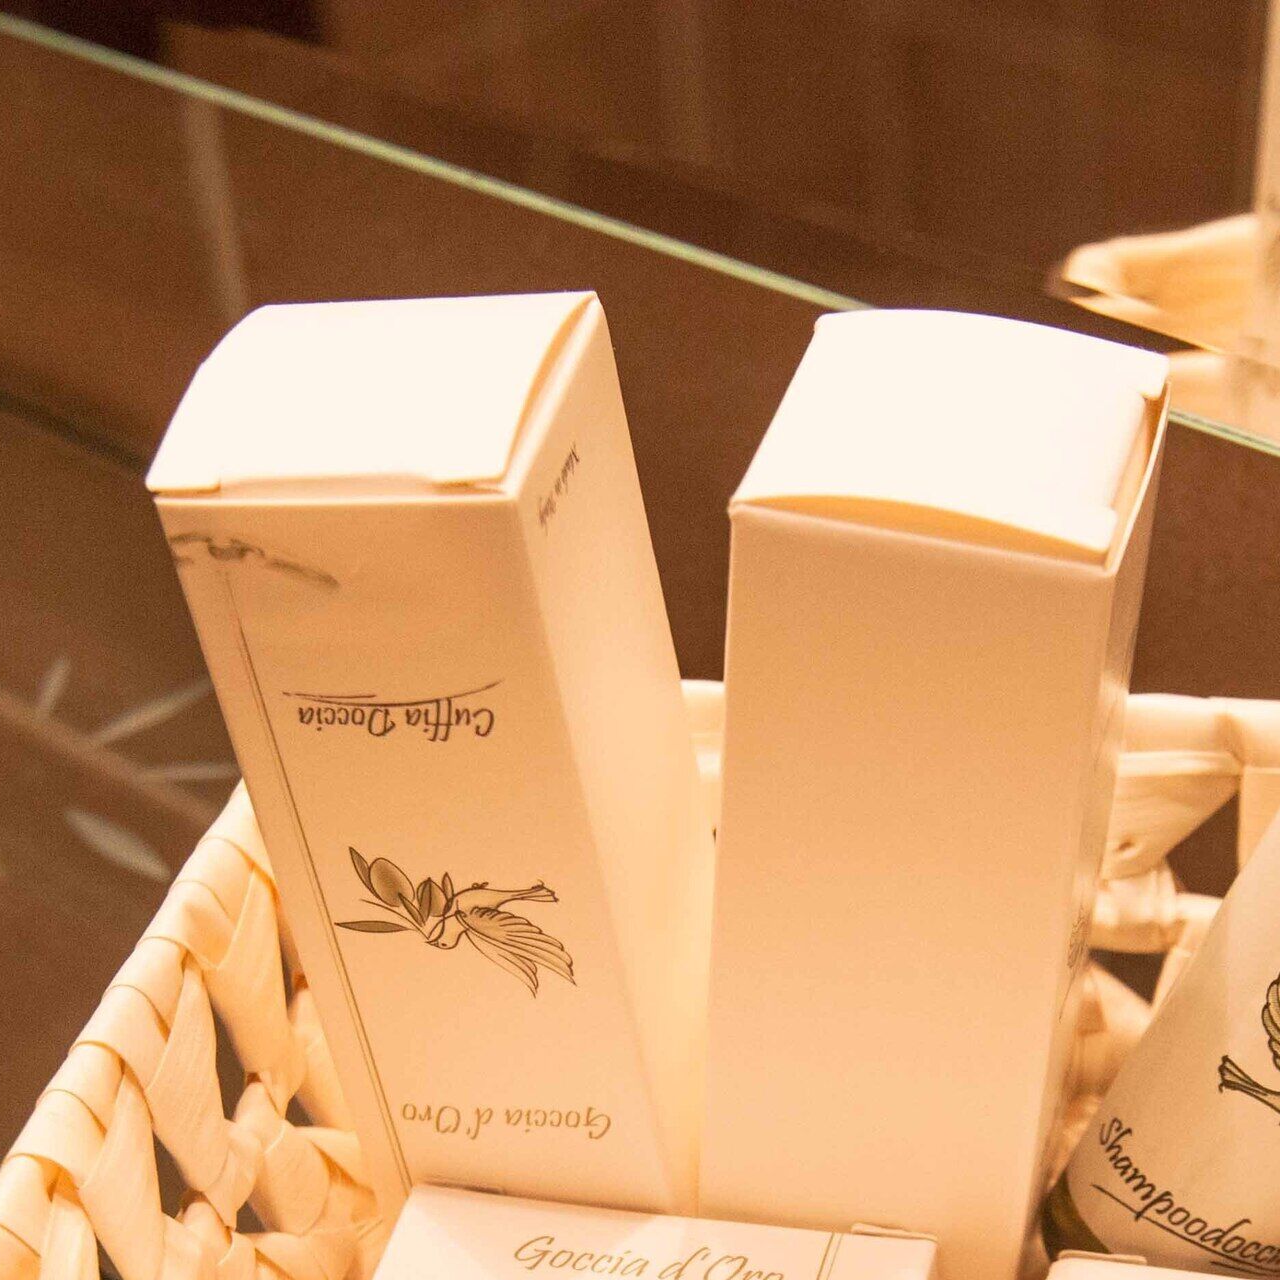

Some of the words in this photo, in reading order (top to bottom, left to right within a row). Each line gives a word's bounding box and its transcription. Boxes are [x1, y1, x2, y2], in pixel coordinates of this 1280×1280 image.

[298, 705, 396, 738] Doccia
[405, 697, 496, 742] Cuffia
[401, 1102, 494, 1141] d'Oro
[504, 1106, 612, 1140] Goccia
[513, 1235, 652, 1279] Goccia
